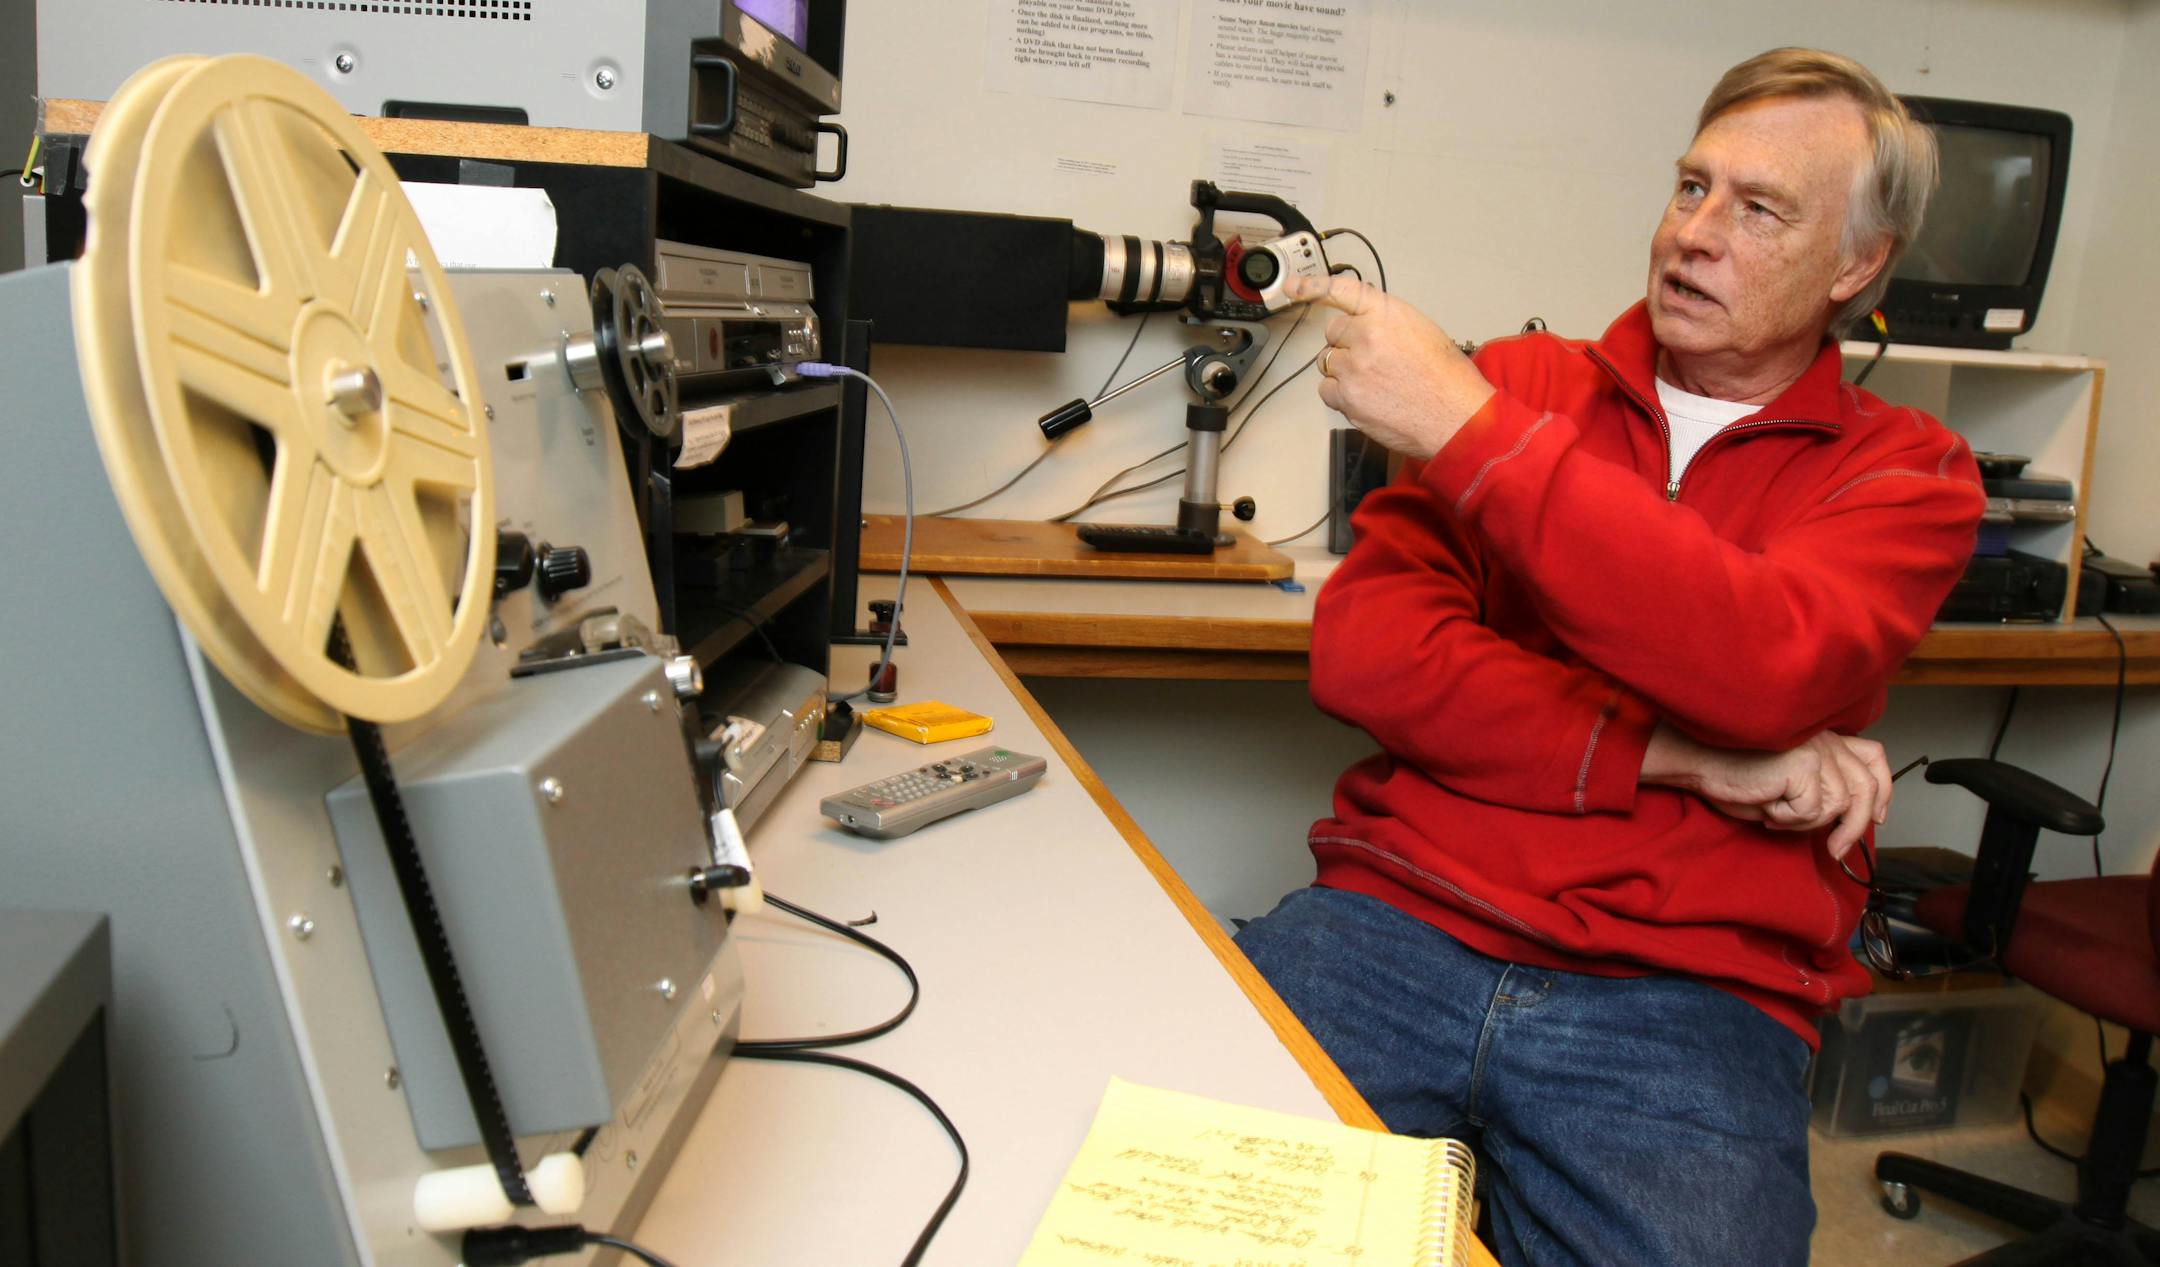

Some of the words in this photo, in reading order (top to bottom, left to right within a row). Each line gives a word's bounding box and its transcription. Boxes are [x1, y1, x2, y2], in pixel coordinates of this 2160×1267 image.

[1096, 6, 1113, 14] DVD
[1114, 9, 1135, 18] player
[1266, 0, 1291, 9] movie
[1293, 1, 1314, 13] have
[1316, 6, 1346, 17] sound?
[1018, 8, 1035, 16] Once
[1037, 10, 1048, 18] the
[1049, 12, 1063, 20] disk
[1104, 19, 1129, 29] nothing
[1131, 22, 1148, 30] more
[1041, 20, 1061, 29] added
[1238, 16, 1257, 26] Super
[1023, 37, 1041, 46] DVD
[1042, 39, 1056, 48] disk
[1057, 41, 1071, 49] that
[1073, 43, 1084, 51] has
[1098, 45, 1114, 54] been
[1115, 47, 1144, 57] finalized
[1216, 42, 1236, 51] Please
[1014, 46, 1027, 54] can
[1038, 48, 1065, 58] brought
[1066, 51, 1083, 60] back
[1092, 55, 1117, 63] resume
[1118, 58, 1150, 68] recording
[1014, 55, 1031, 64] right
[1033, 57, 1053, 65] where
[1054, 59, 1067, 67] you
[1068, 60, 1080, 69] left
[1221, 72, 1233, 80] you
[1872, 1100, 1898, 1117] Final
[1899, 1099, 1918, 1114] Cut
